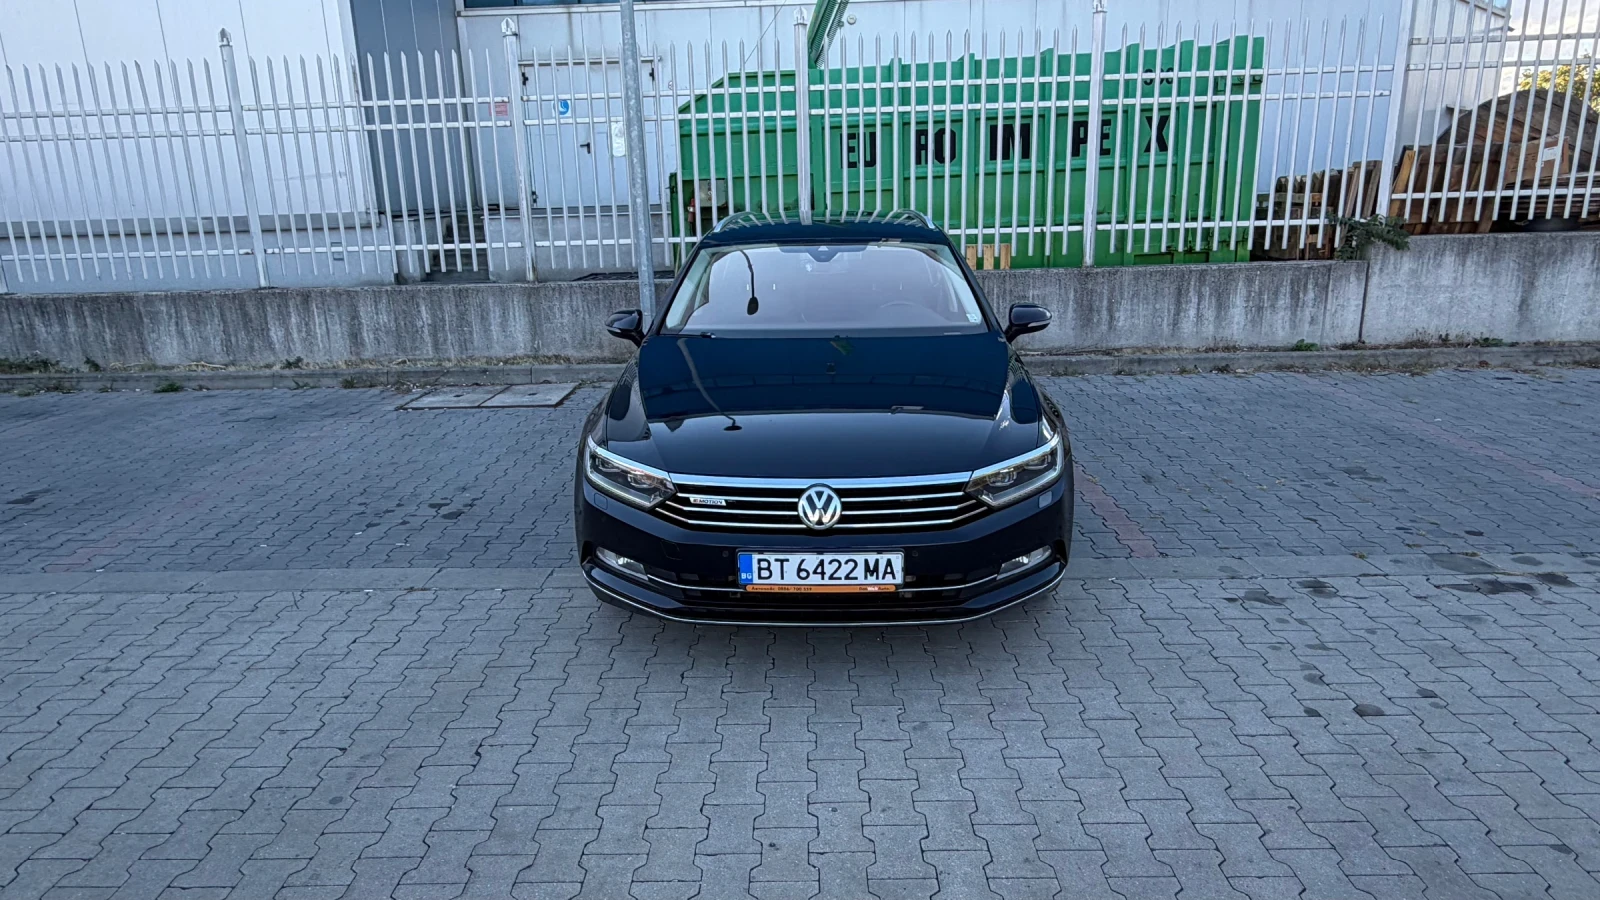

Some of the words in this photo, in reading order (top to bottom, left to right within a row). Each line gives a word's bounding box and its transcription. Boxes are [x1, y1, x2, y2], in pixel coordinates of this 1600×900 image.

[741, 572, 752, 580] BG
[757, 558, 790, 580] BT
[796, 558, 859, 580] 6422
[863, 558, 897, 580] MA
